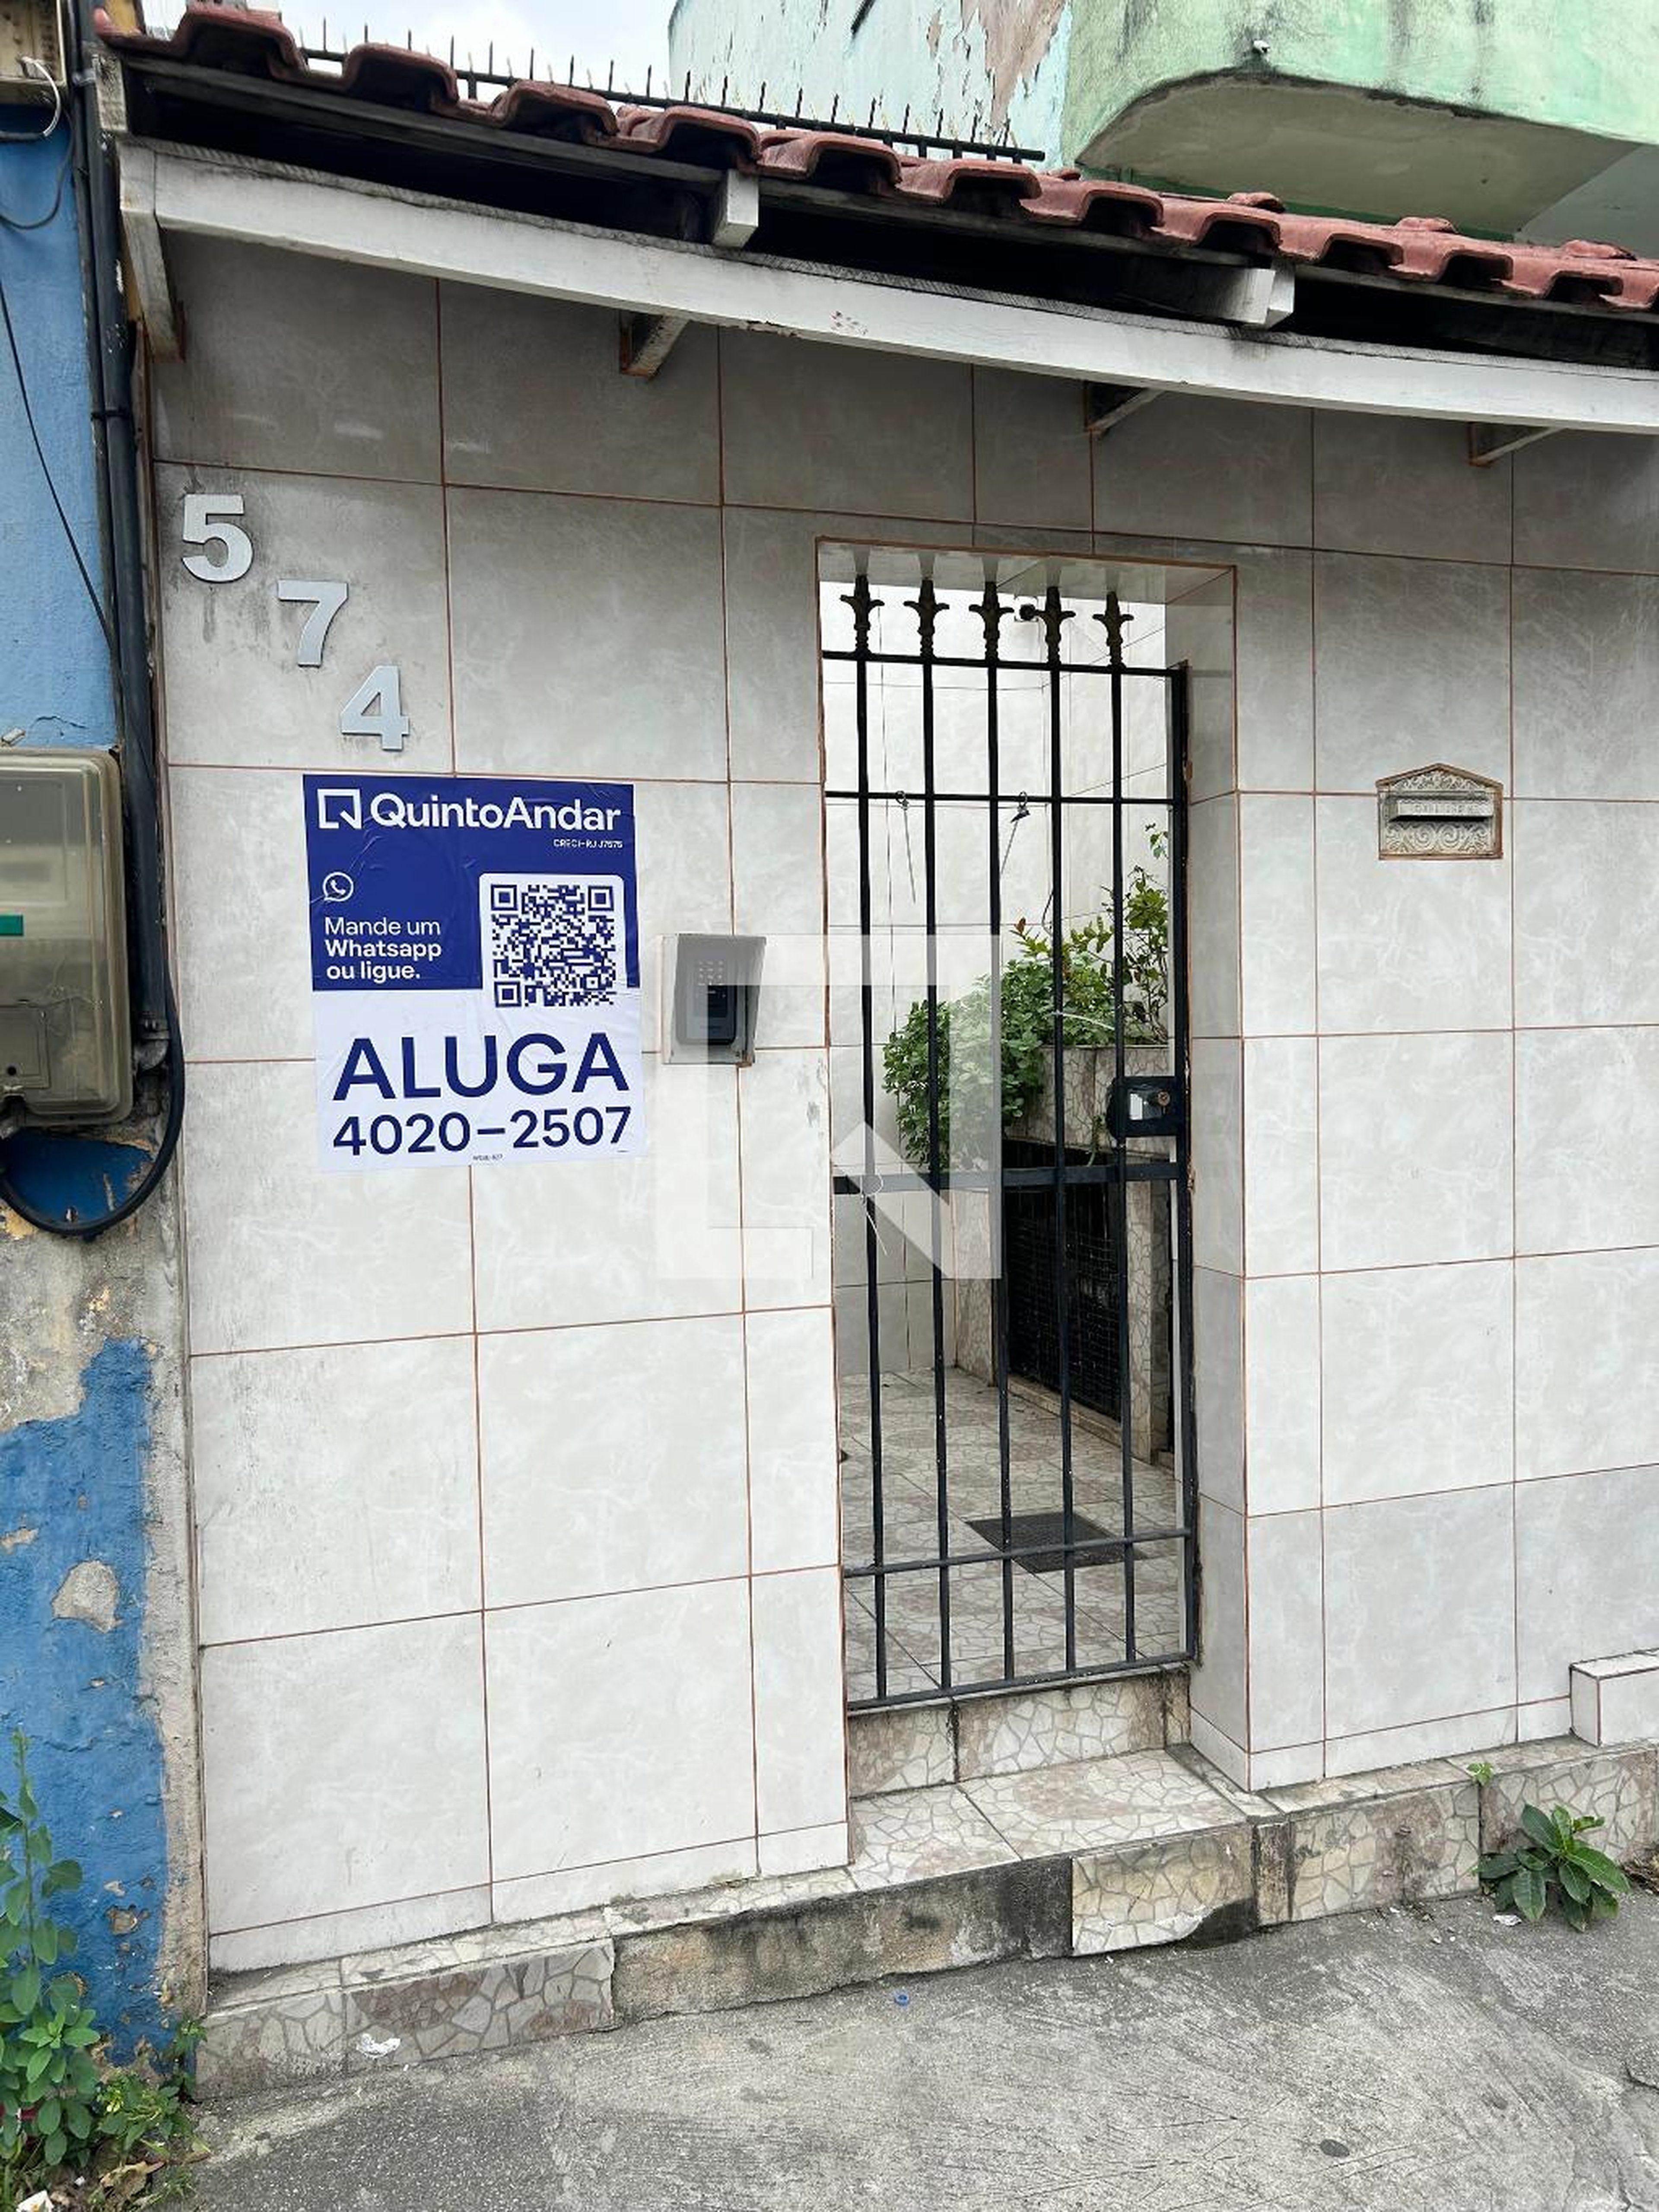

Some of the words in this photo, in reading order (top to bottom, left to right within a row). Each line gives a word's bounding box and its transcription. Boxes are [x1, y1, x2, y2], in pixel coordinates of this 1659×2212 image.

[370, 793, 621, 831] QuintoAndar
[325, 917, 401, 936] Mande
[407, 921, 441, 936] um
[324, 939, 442, 962] Whatsapp
[326, 965, 355, 980] ou
[360, 961, 420, 984] ligue.
[333, 1032, 630, 1101] ALUGA
